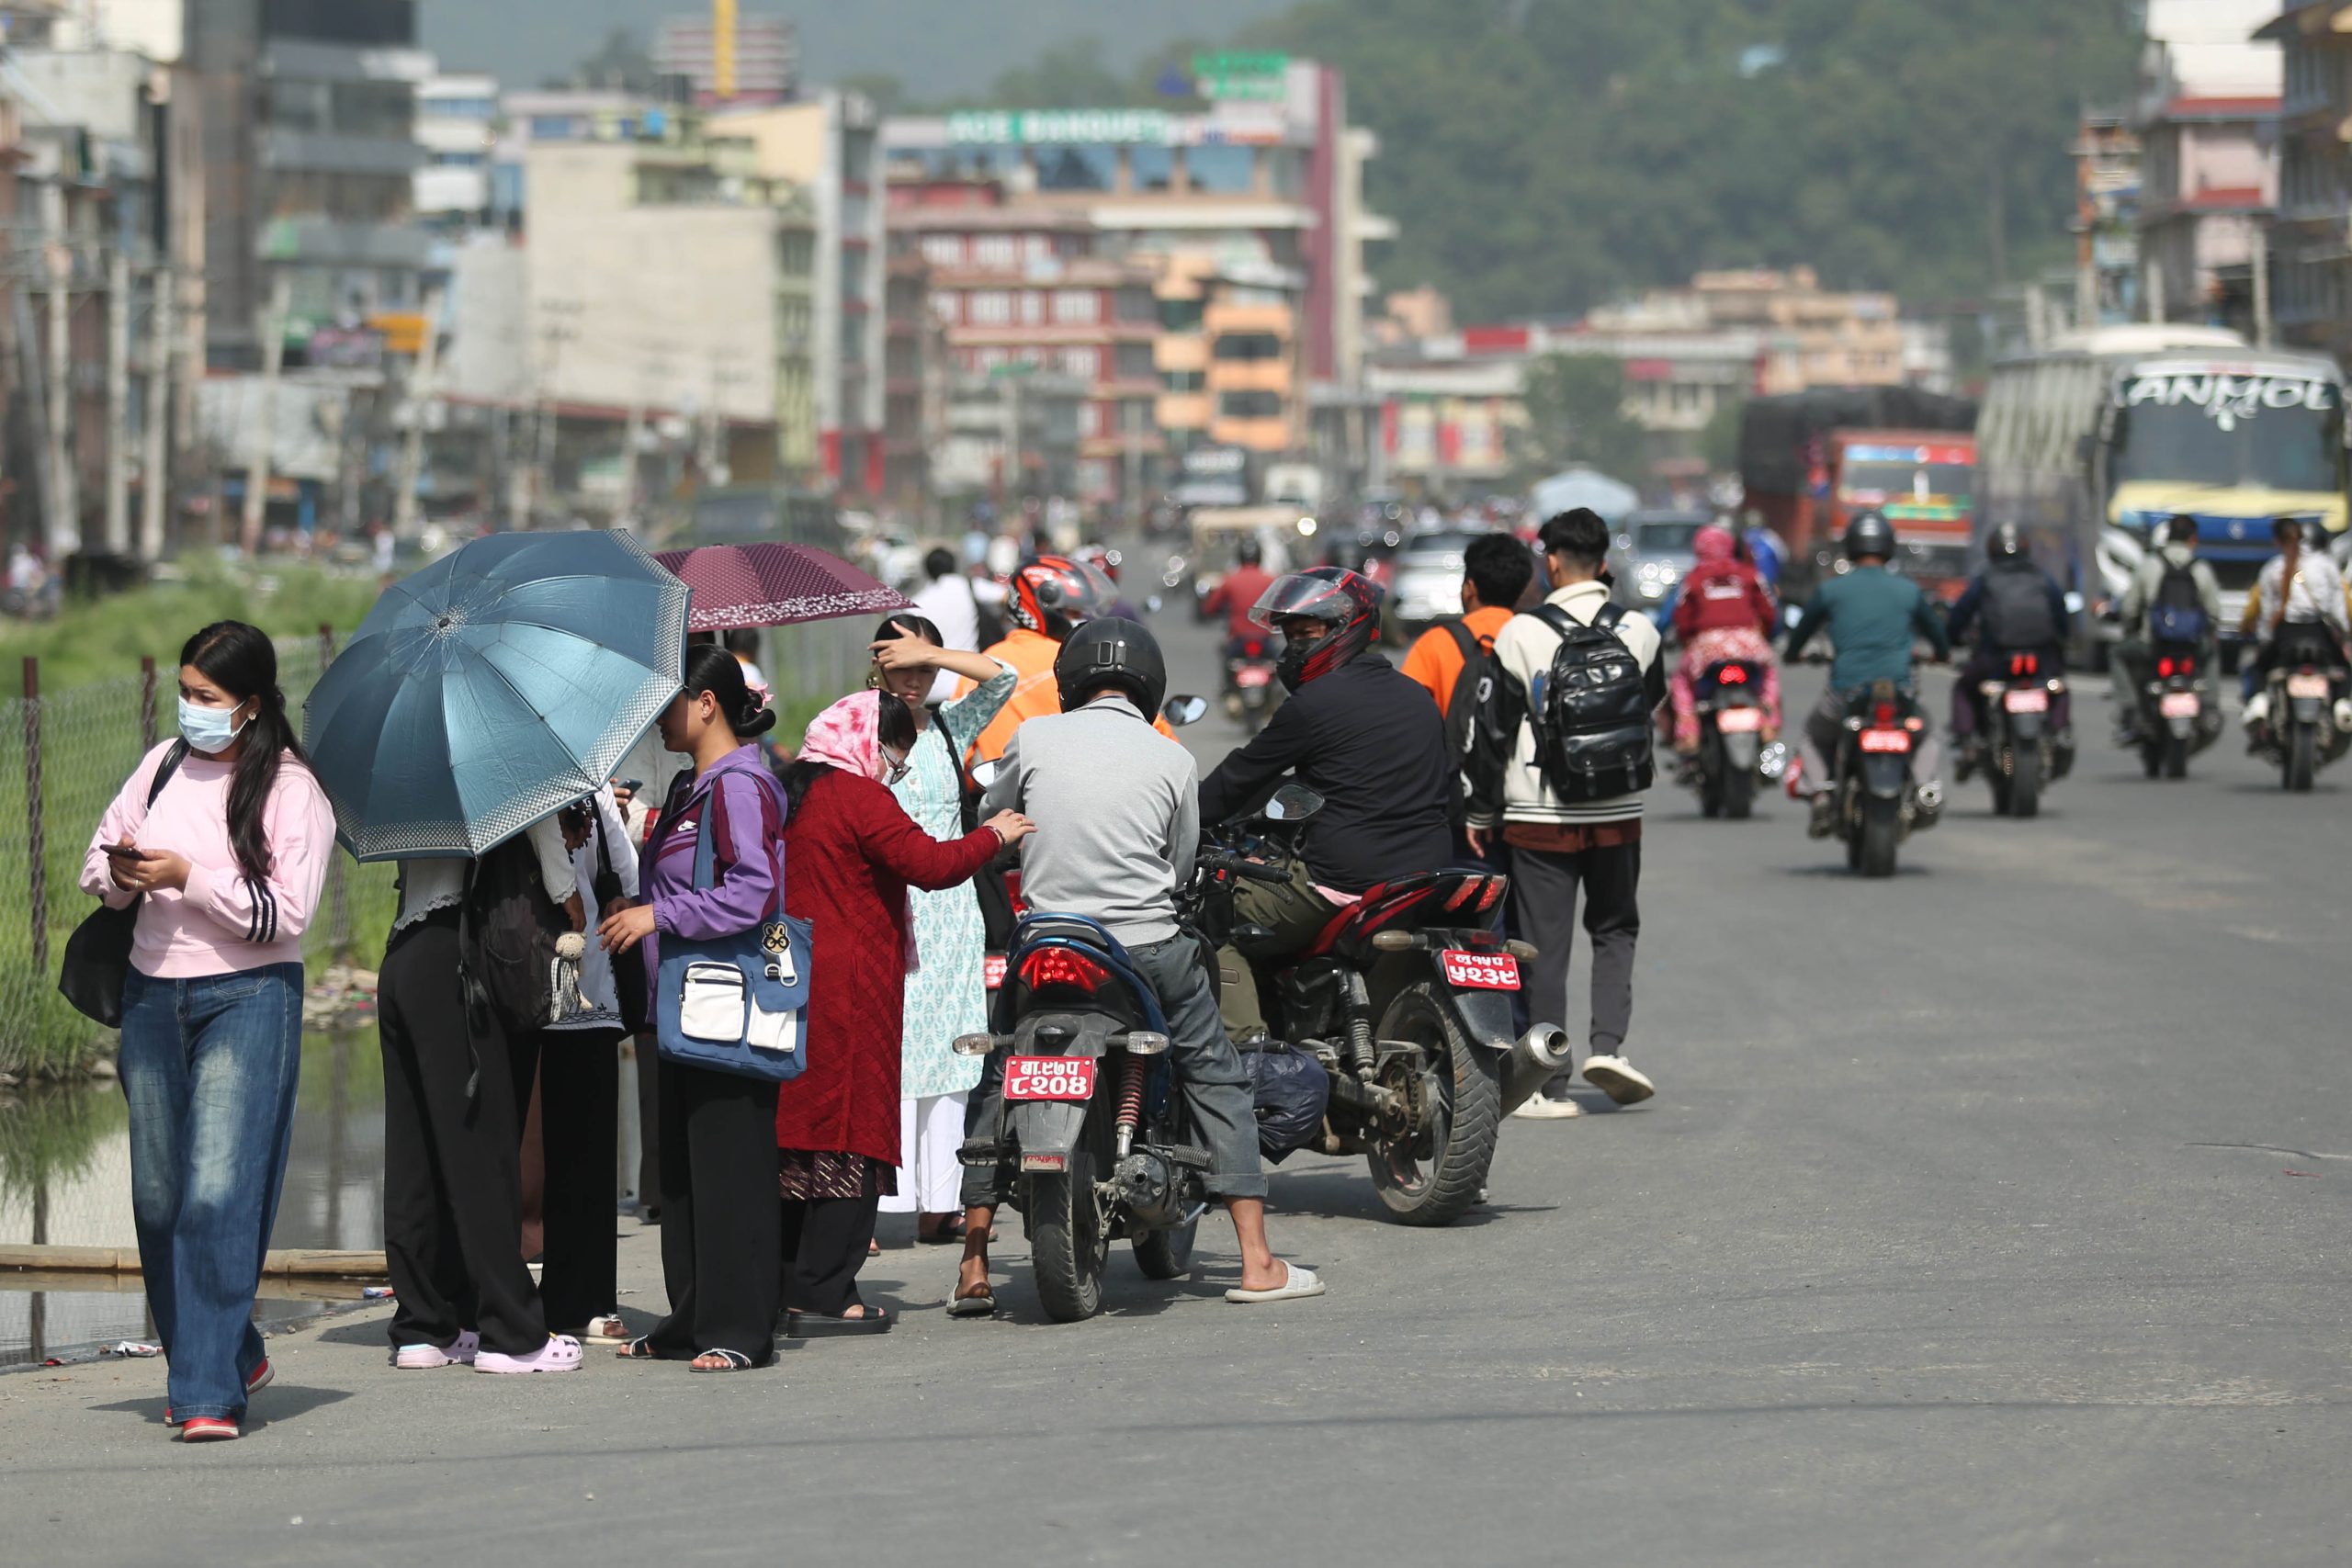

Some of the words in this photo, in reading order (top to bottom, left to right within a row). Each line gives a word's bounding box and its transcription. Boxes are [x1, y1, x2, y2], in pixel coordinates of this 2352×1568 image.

[2128, 376, 2334, 410] ANMOL
[1449, 965, 1517, 986] ५२३९
[1011, 1076, 1087, 1095] ८२०४
